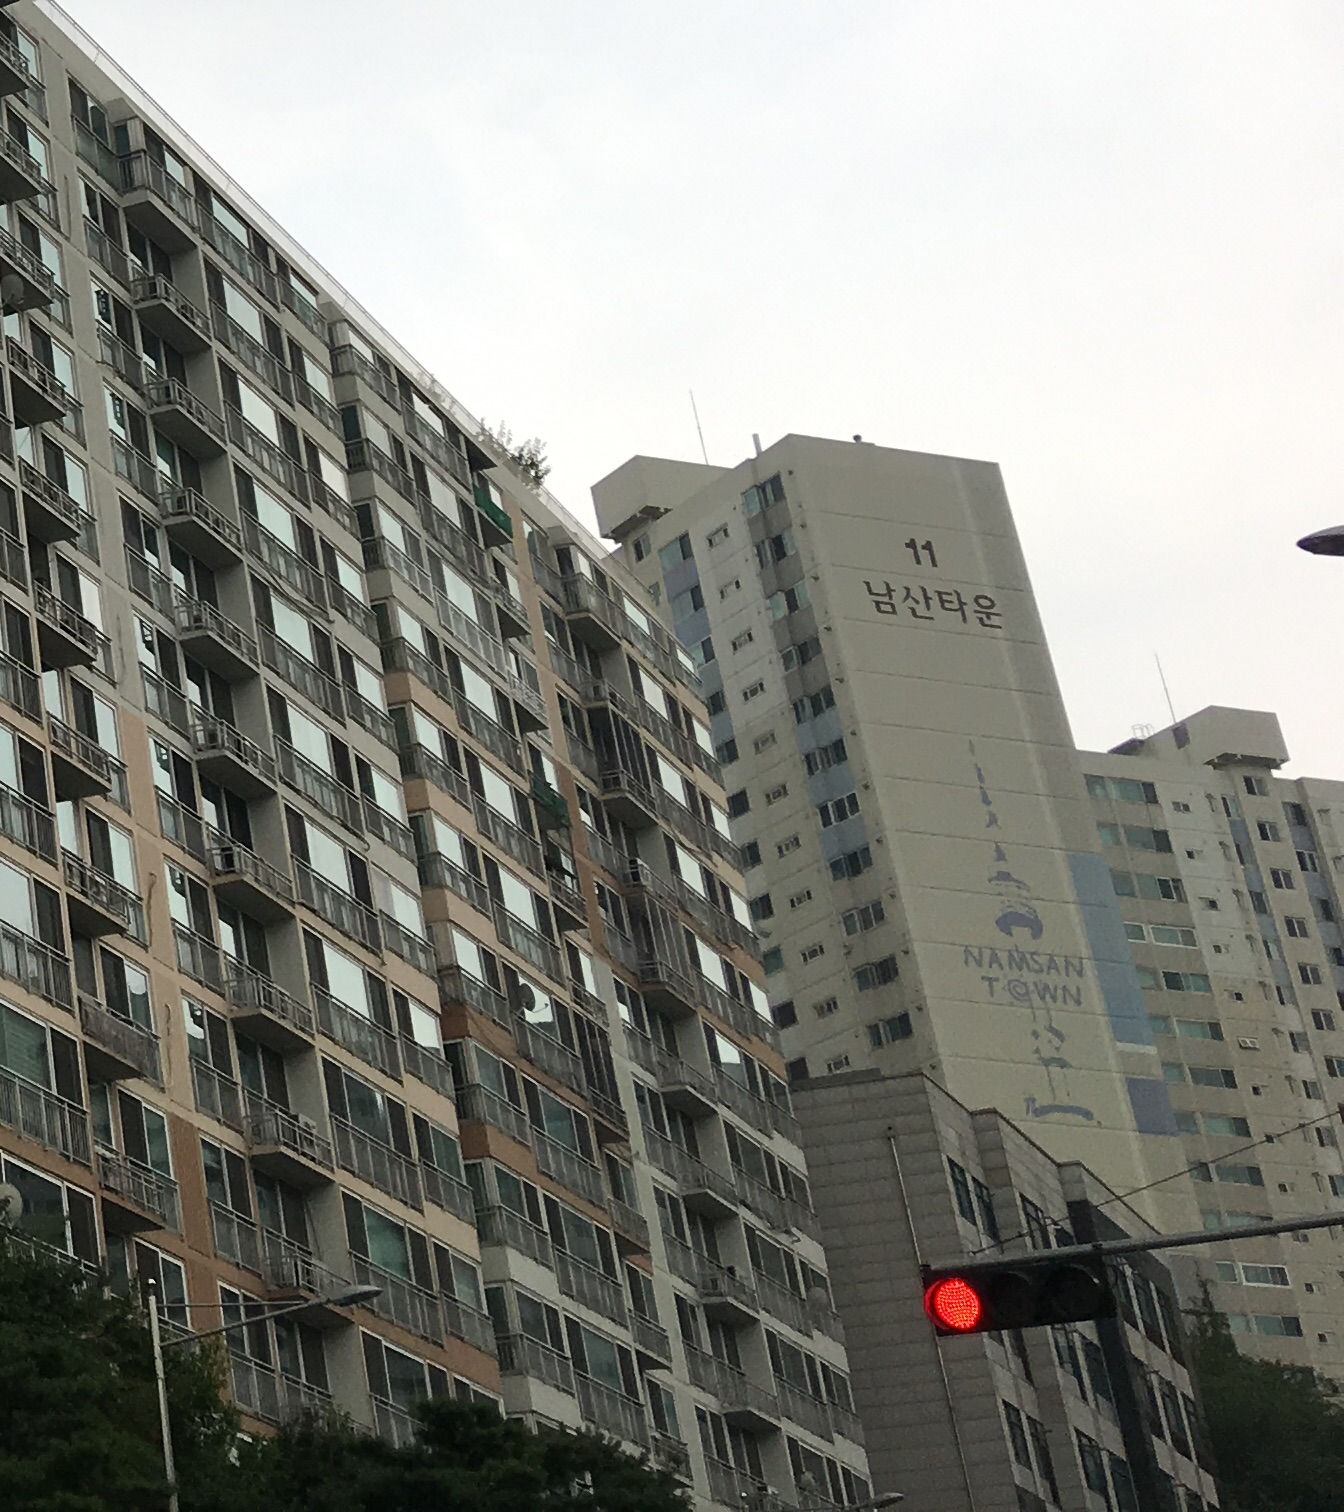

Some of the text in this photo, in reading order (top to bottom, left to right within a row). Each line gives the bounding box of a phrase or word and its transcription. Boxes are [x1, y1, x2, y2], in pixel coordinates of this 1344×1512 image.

[904, 537, 939, 568] 11
[862, 580, 1003, 630] 남산타운
[962, 945, 1085, 978] NAMSAN
